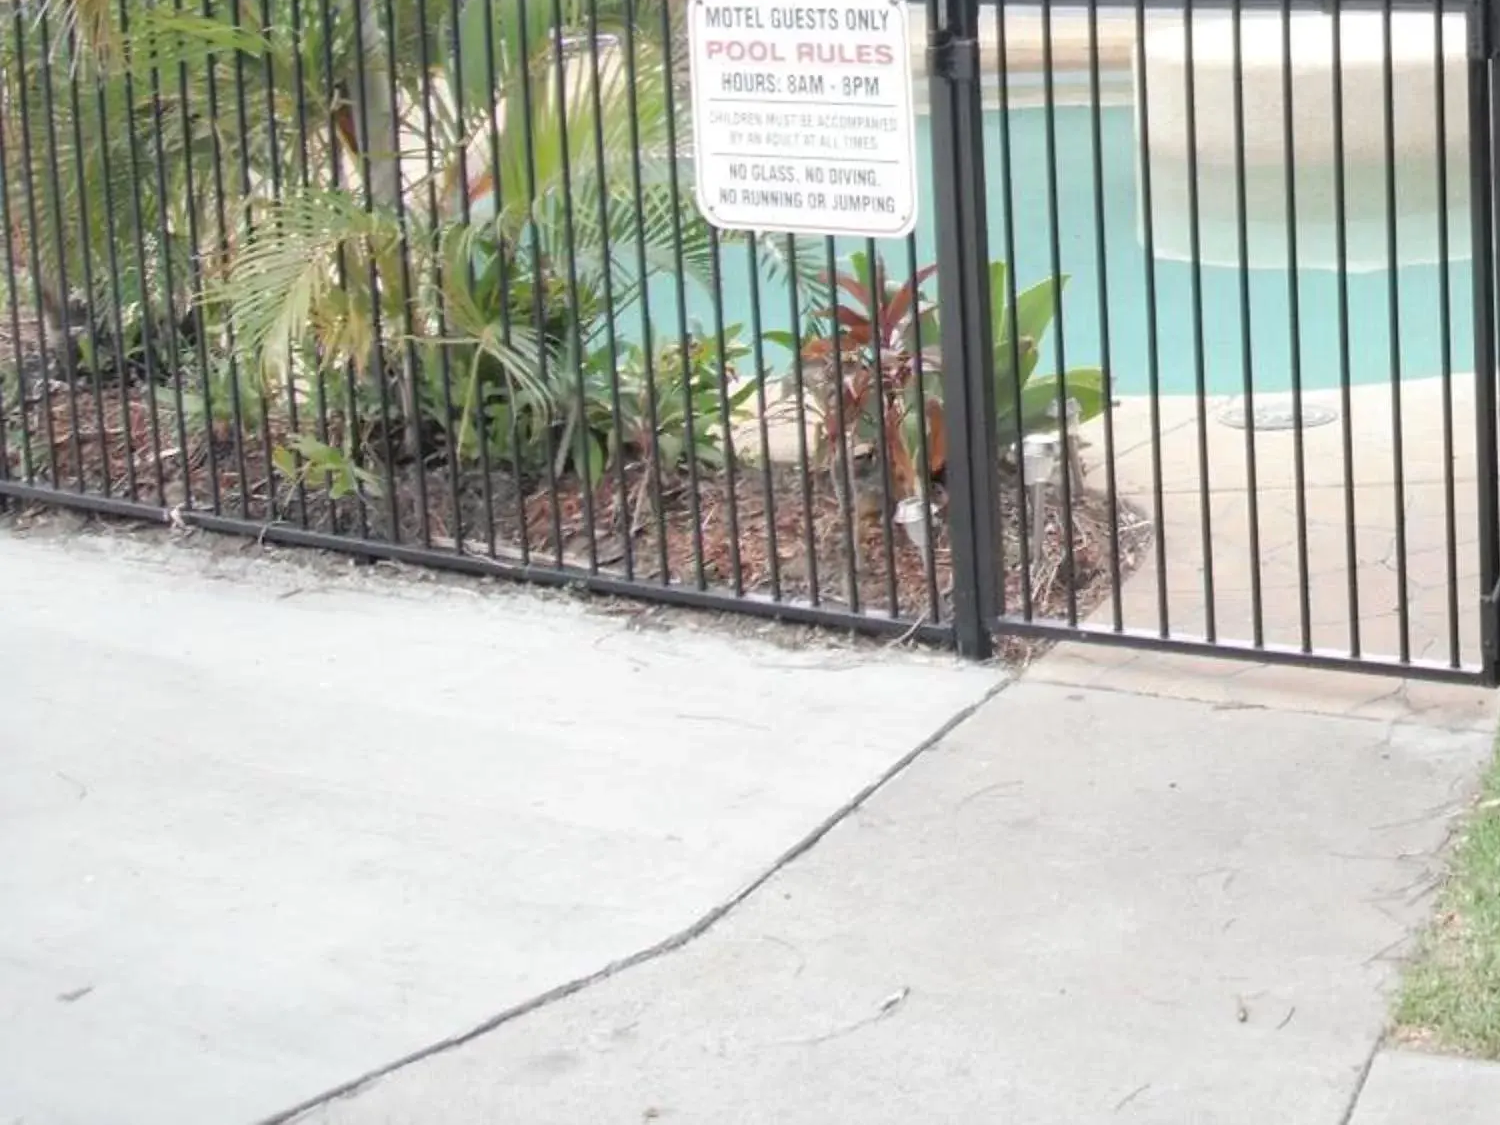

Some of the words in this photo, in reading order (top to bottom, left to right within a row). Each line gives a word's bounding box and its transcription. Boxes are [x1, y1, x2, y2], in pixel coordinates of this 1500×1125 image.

[706, 7, 764, 28] MOTEL
[771, 7, 839, 29] GUESTS
[845, 8, 889, 31] ONLY
[706, 41, 786, 61] POOL
[797, 43, 894, 64] RULES
[722, 72, 782, 93] HOURS:
[787, 74, 825, 94] 8AM
[710, 111, 762, 126] CHILDREN
[766, 113, 797, 127] MUST
[801, 113, 814, 128] BE
[748, 132, 761, 145] AN
[804, 134, 816, 147] AT
[820, 134, 838, 148] ALL
[729, 163, 746, 180] NO
[805, 166, 824, 183] NO
[719, 187, 736, 204] NO
[741, 189, 803, 208] RUNNING
[807, 193, 826, 209] OR
[832, 194, 895, 214] JUMPING
